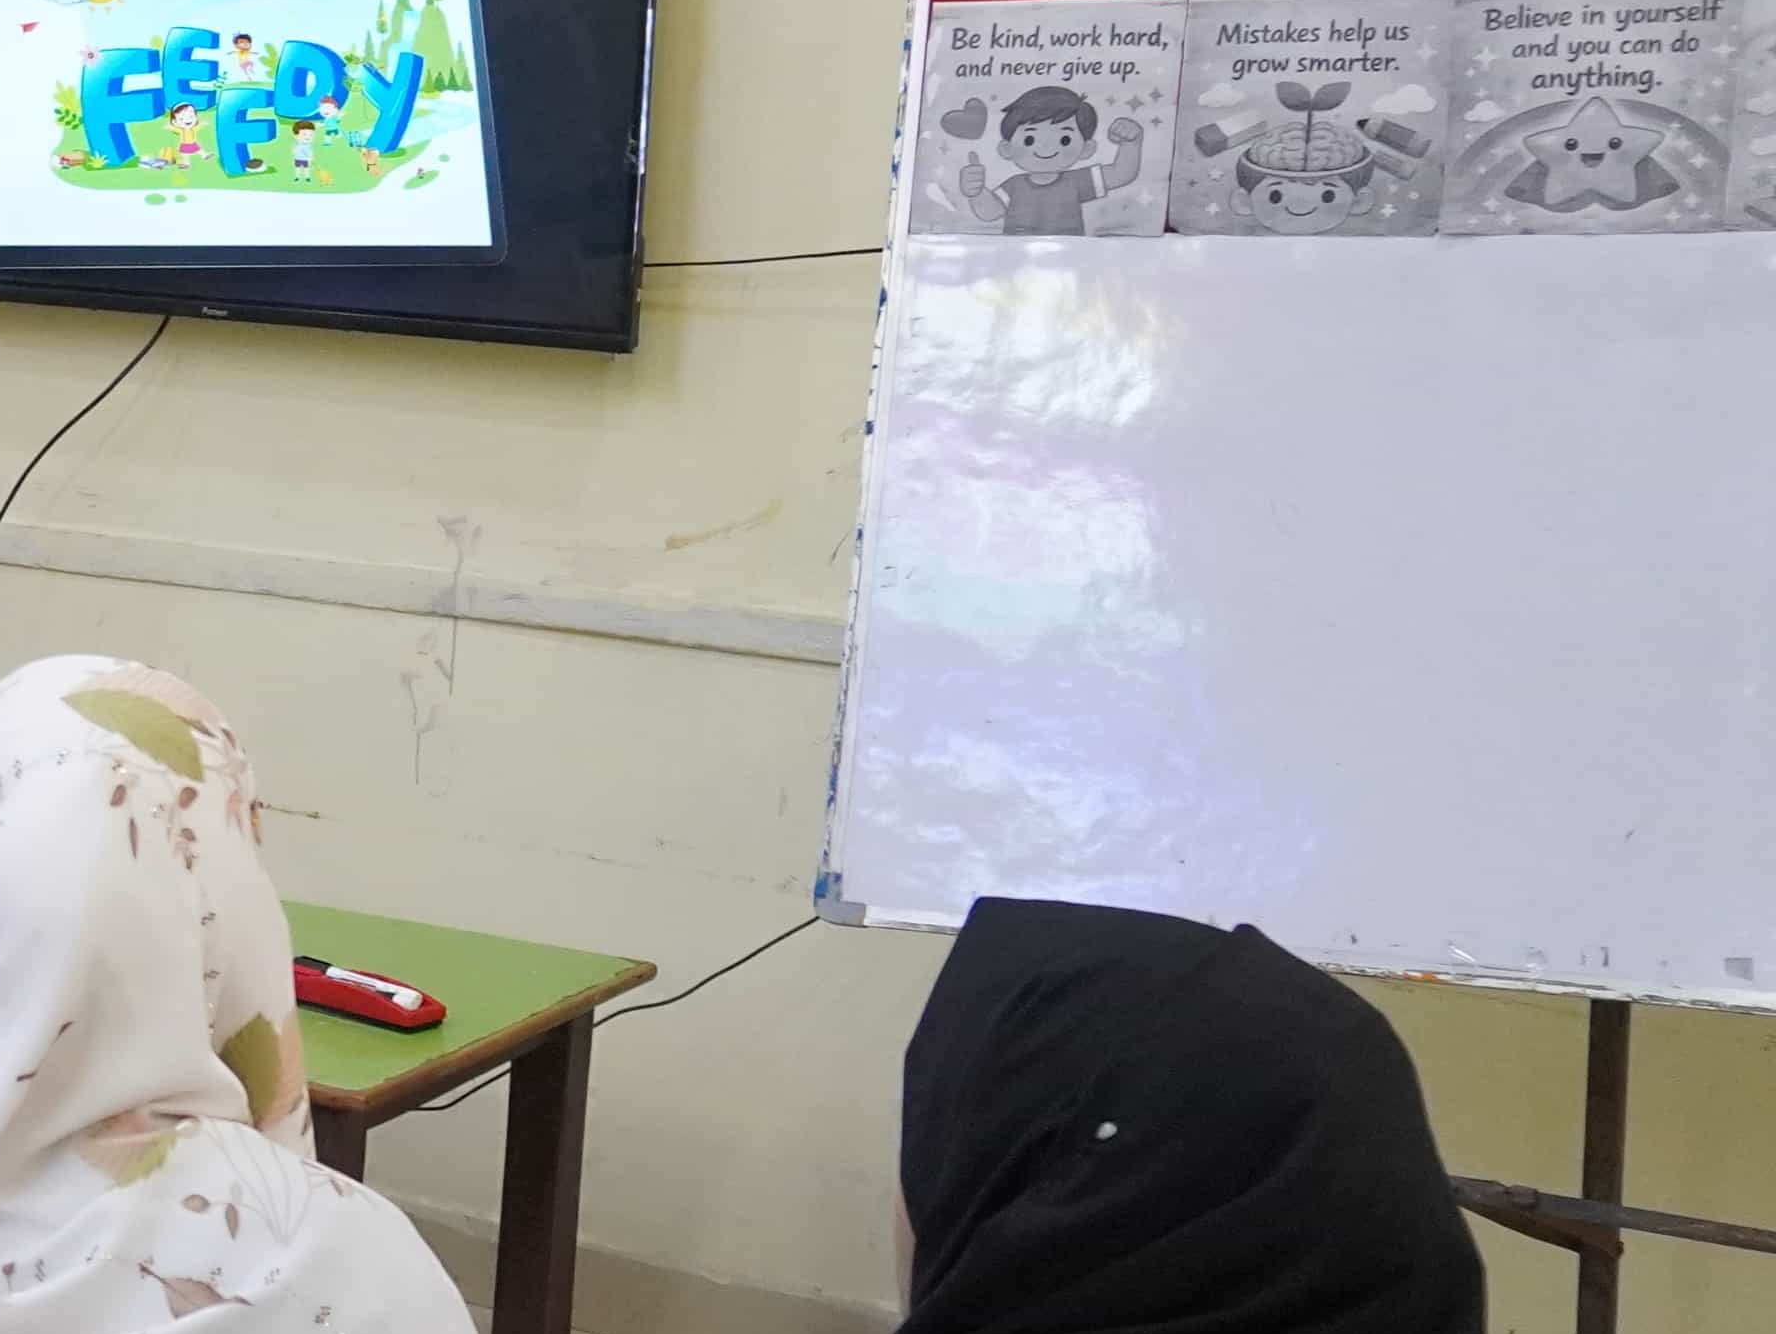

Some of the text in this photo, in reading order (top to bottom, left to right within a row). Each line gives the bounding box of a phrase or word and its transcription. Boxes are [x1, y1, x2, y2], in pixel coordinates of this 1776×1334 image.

[1483, 5, 1572, 31] Believe
[1582, 4, 1605, 25] in
[952, 22, 1168, 52] Be kind, work hard,
[1217, 19, 1409, 46] Mistakes help us
[1513, 31, 1700, 62] and you can do
[956, 58, 1141, 82] and never give up.
[1232, 53, 1399, 80] grow smarter.
[1532, 68, 1663, 95] anything.
